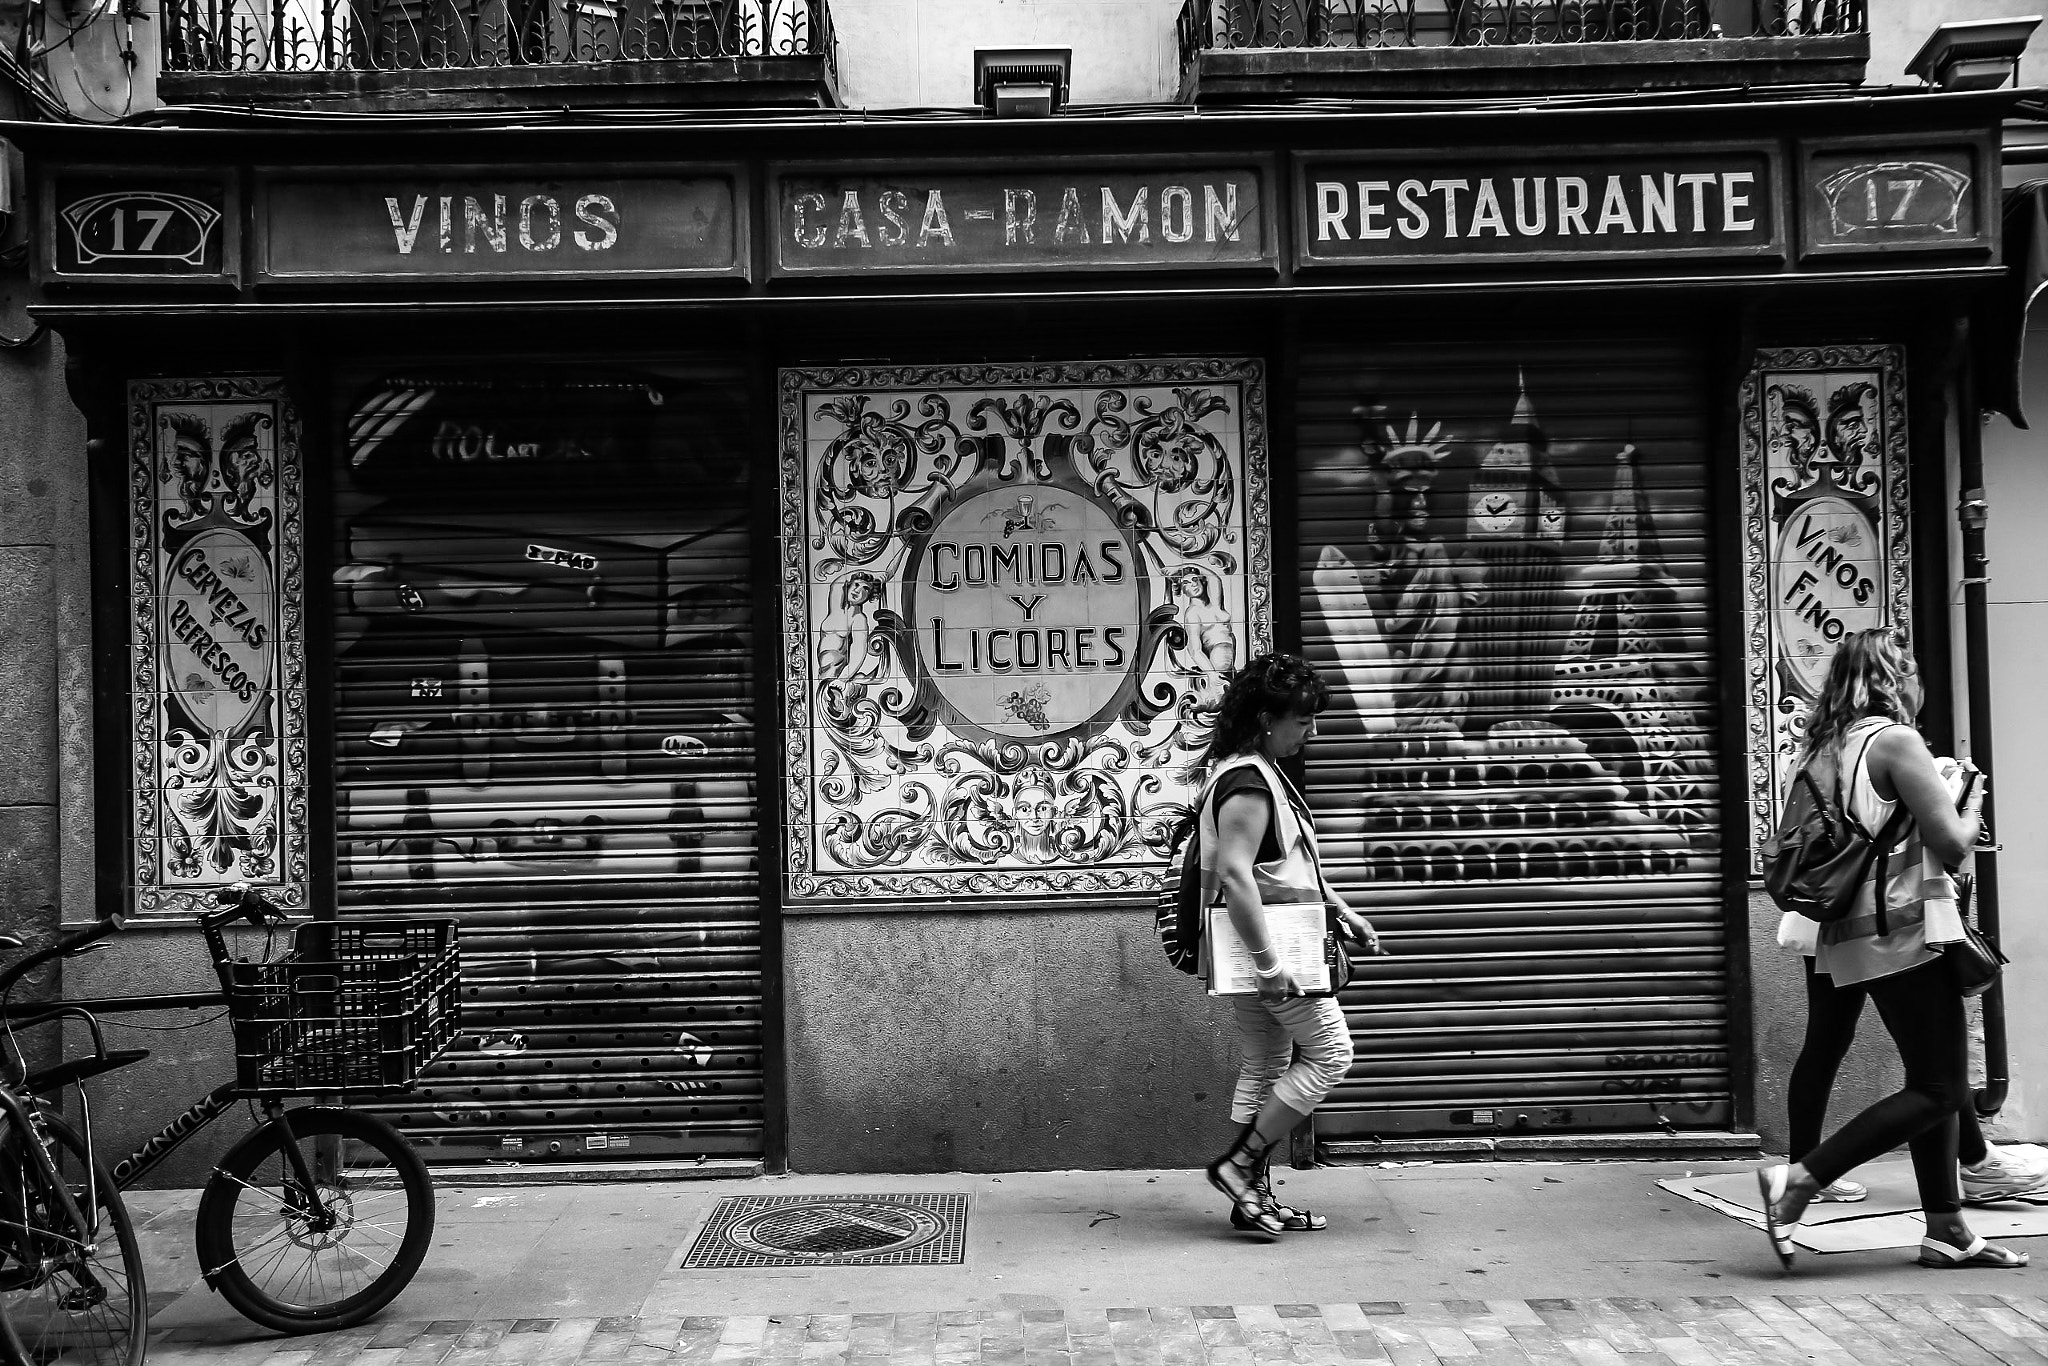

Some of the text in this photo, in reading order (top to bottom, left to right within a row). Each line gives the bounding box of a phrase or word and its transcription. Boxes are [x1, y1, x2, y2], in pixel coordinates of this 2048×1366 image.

[107, 207, 173, 252] 17
[385, 192, 618, 254] VINOS
[1315, 171, 1756, 242] RESTAURANTE
[1864, 178, 1922, 223] 17
[928, 541, 1124, 591] COMIDAS
[1796, 515, 1875, 606] VINOS
[178, 549, 267, 650] CERVEZAS
[209, 610, 223, 627] Y
[1009, 595, 1047, 622] Y
[170, 600, 257, 702] REFRESCOS
[930, 617, 1126, 671] LICORES
[114, 1094, 223, 1179] OMNIUM
